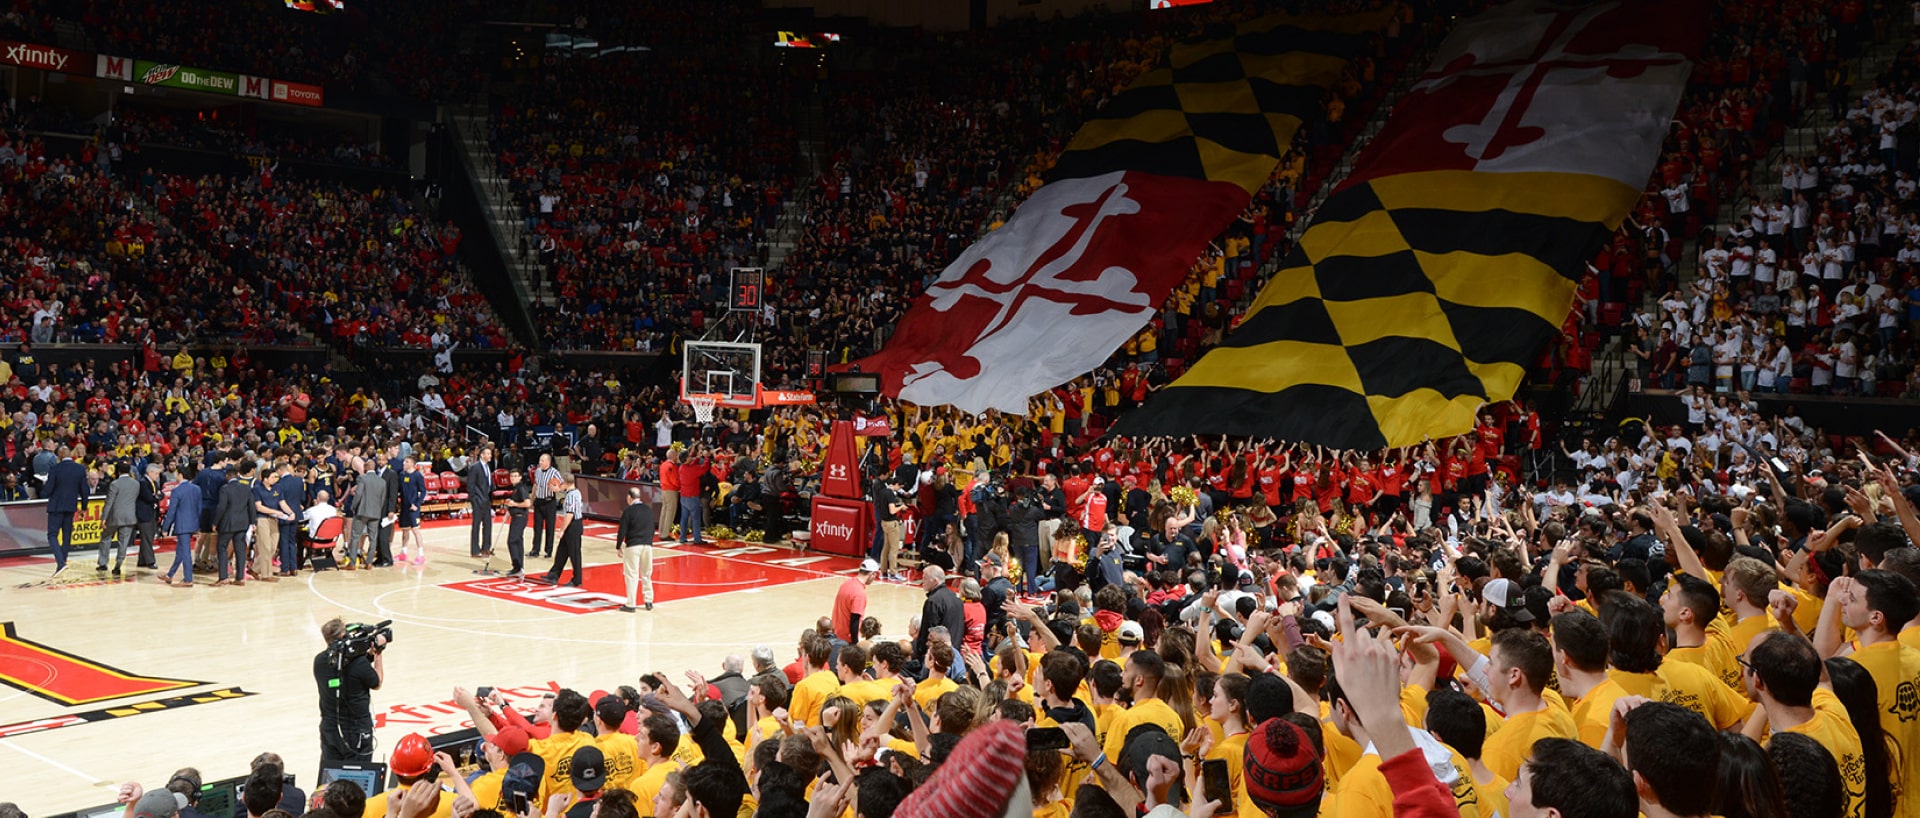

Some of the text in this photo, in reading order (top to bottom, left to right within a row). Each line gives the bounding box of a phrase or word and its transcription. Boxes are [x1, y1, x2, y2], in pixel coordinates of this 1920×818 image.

[6, 44, 69, 70] xfinity
[106, 56, 124, 76] M
[181, 72, 234, 90] DO THE DEW
[246, 78, 261, 95] M
[290, 89, 321, 100] TOYOTA
[737, 285, 757, 306] 30
[809, 363, 821, 375] 30
[816, 520, 853, 541] xfinity
